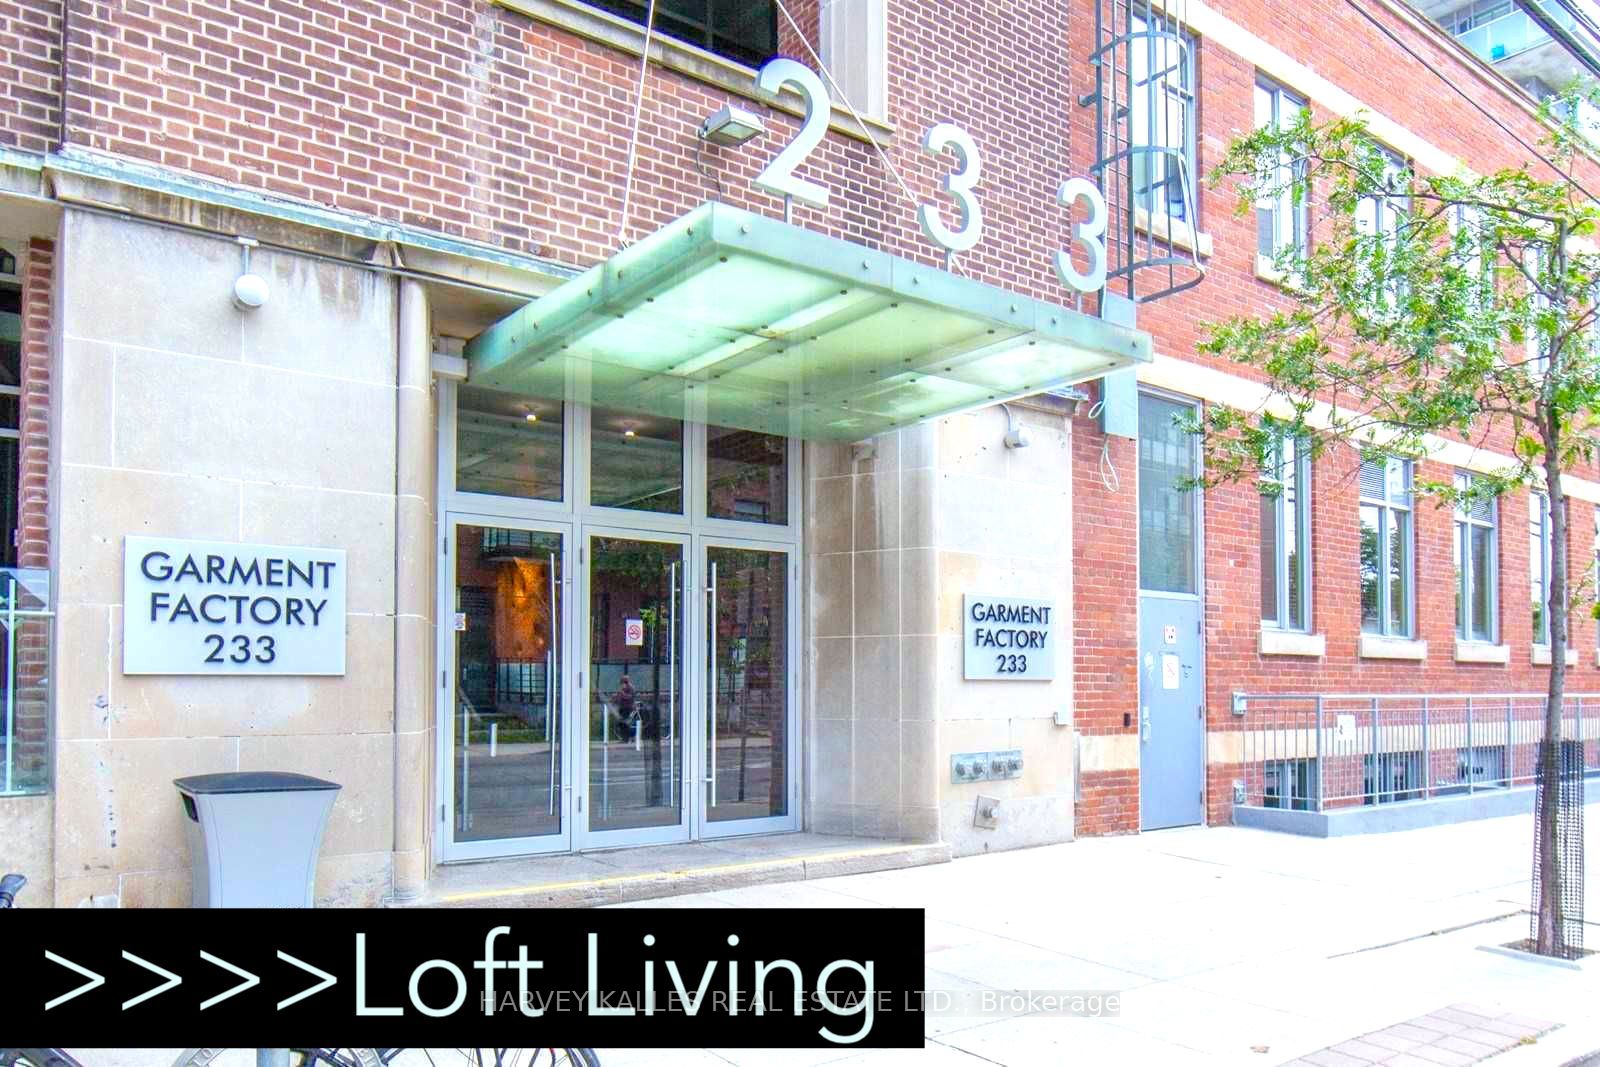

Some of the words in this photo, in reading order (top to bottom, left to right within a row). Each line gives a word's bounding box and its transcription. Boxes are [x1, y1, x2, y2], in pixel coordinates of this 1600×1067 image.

[140, 551, 336, 589] GARMENT
[150, 592, 328, 626] FACTORY
[972, 602, 1051, 625] GARMENT
[204, 634, 276, 664] 233
[975, 628, 1048, 649] FACTORY
[997, 654, 1027, 673] 233
